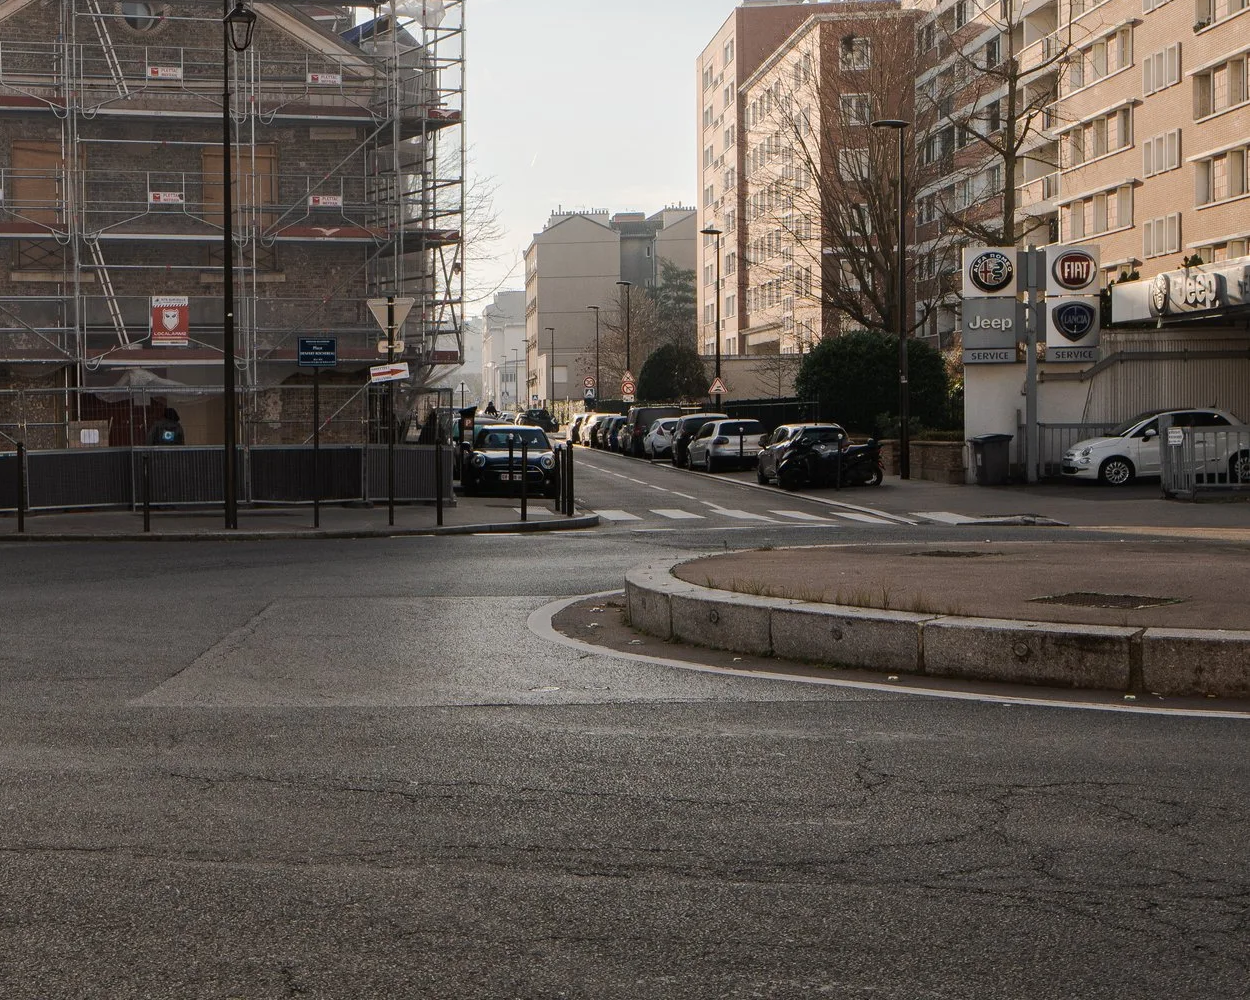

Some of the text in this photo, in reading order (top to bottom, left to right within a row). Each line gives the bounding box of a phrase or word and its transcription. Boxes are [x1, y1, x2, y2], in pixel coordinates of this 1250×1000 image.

[974, 253, 1012, 273] ALFA ROMEO
[1064, 261, 1088, 279] FIAT
[1172, 273, 1217, 308] Jeep
[968, 315, 1012, 331] Jeep
[1064, 315, 1088, 324] LANCIA
[971, 352, 1009, 360] SERVICE
[1055, 350, 1093, 359] SERVICE
[164, 431, 173, 440] C
